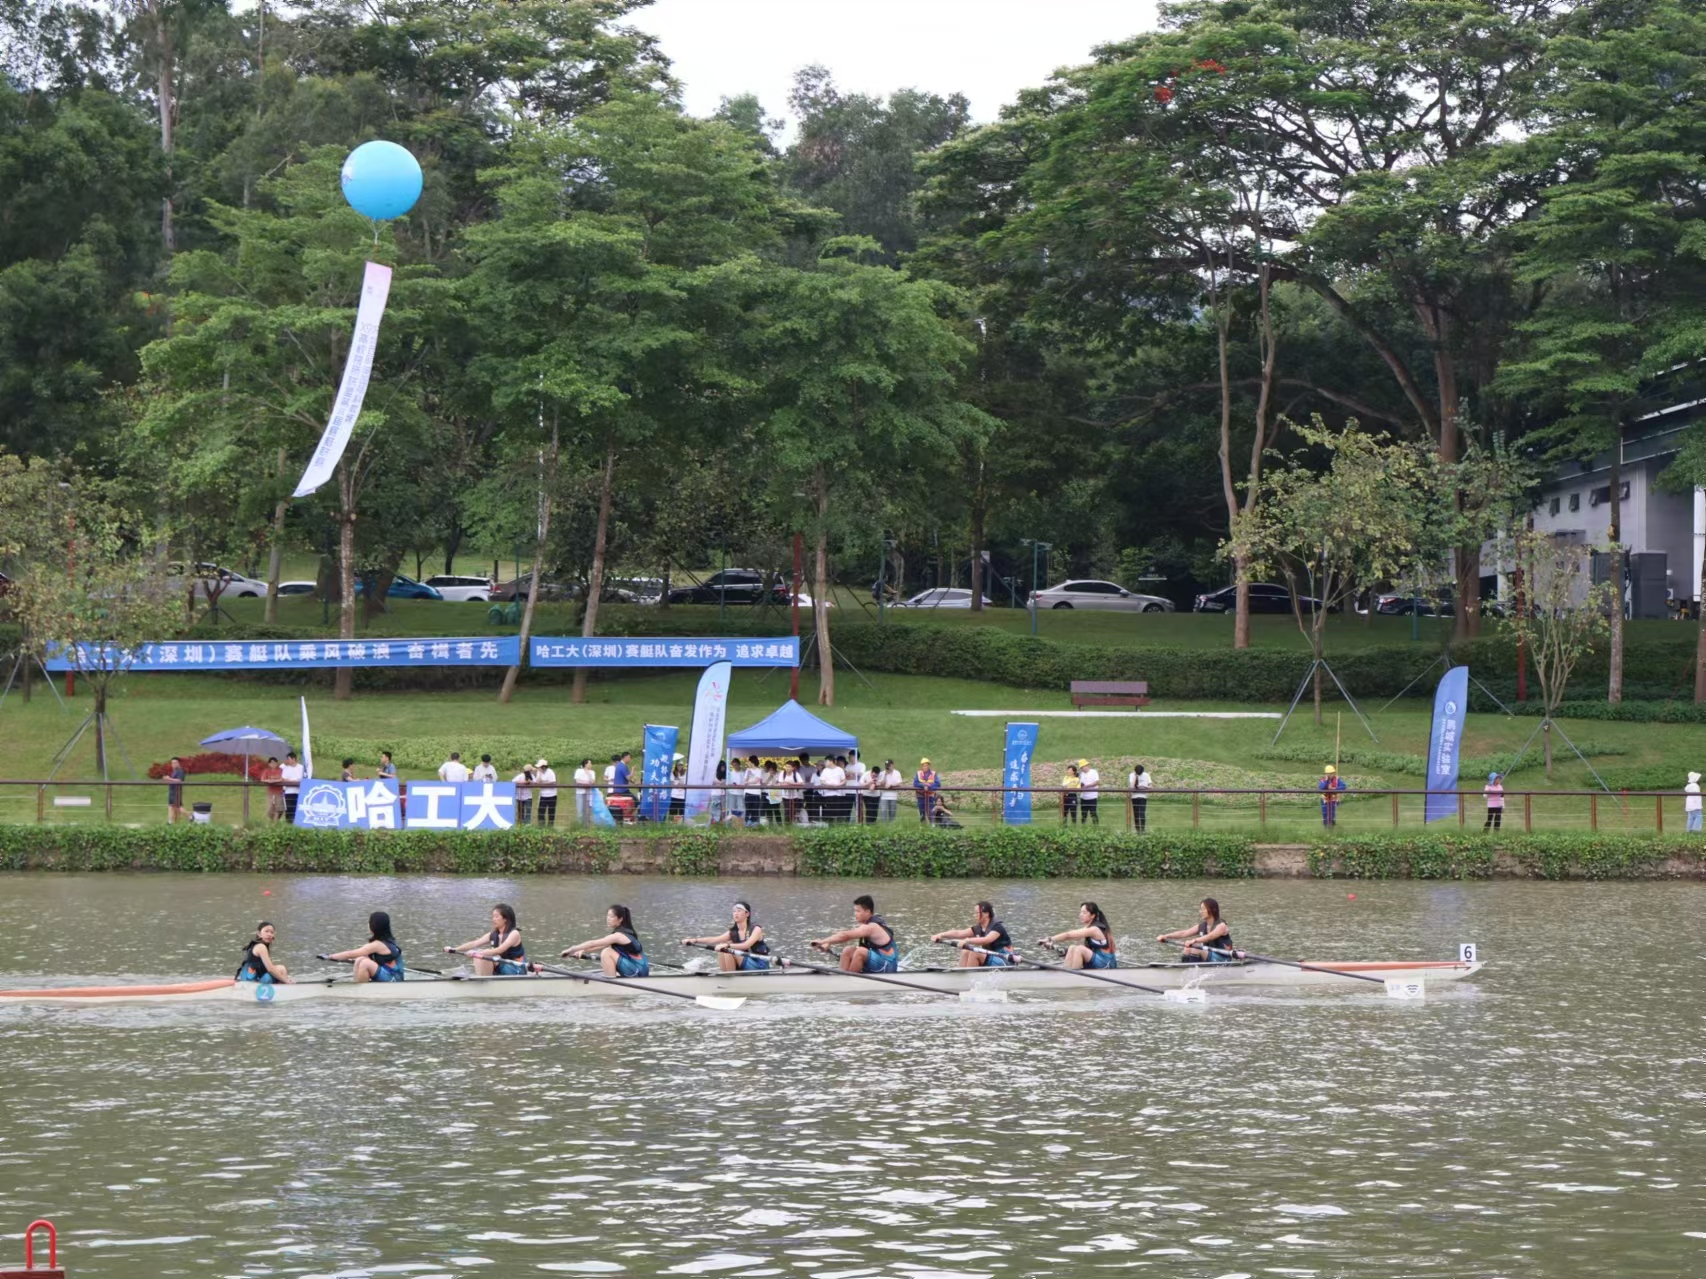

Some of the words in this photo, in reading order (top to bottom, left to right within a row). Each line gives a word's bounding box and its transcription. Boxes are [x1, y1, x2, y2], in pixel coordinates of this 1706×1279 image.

[536, 644, 727, 659] 哈工大（深圳）赛艇队奋发作为
[736, 643, 794, 659] 追求卓越
[346, 781, 513, 830] 哈工大
[1464, 945, 1472, 959] 6
[261, 987, 269, 998] 2
